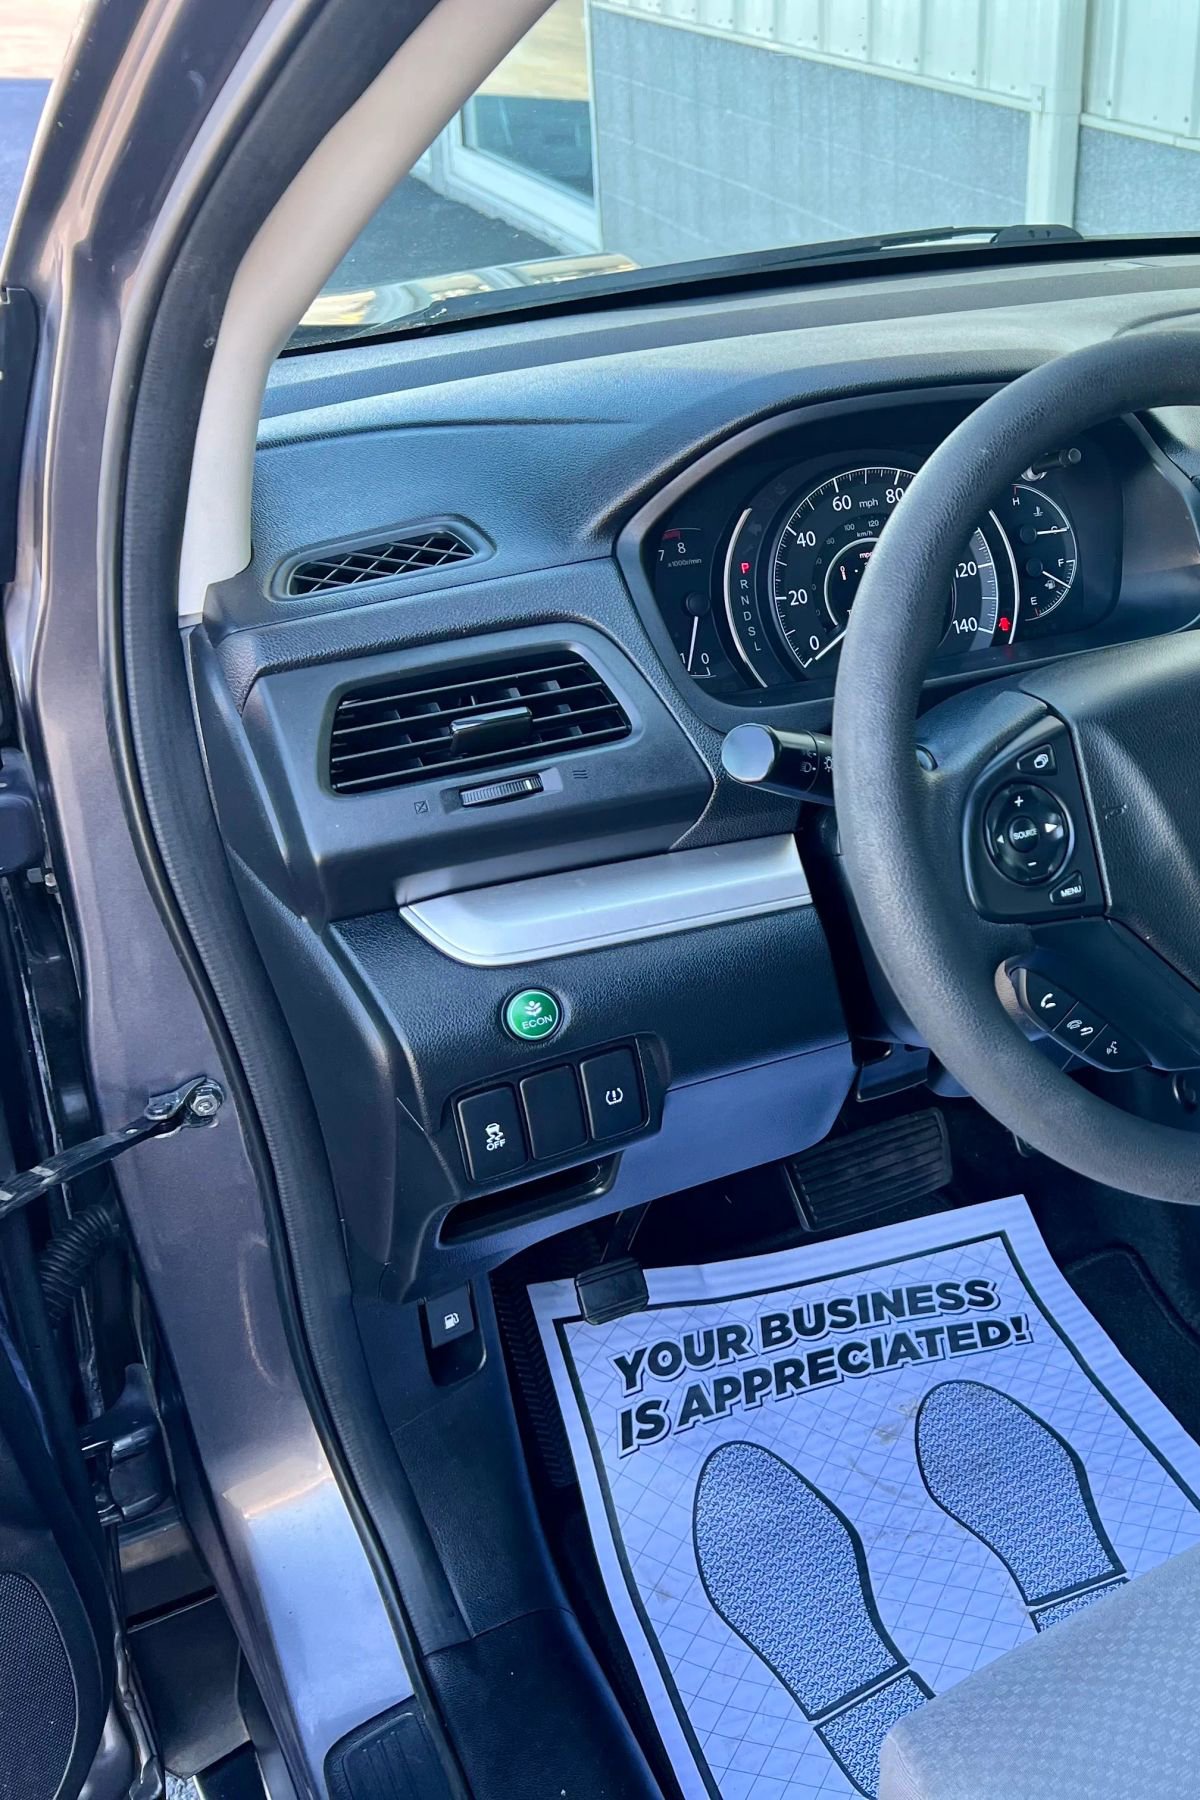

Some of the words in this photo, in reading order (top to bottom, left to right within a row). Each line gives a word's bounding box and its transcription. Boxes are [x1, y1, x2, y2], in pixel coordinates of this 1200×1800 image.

[885, 487, 905, 503] 80
[832, 494, 852, 511] 60
[858, 498, 879, 509] mph
[1012, 497, 1020, 506] H
[844, 523, 855, 531] 100
[868, 519, 879, 528] 120
[796, 530, 816, 547] 40
[856, 530, 873, 538] km/h
[677, 542, 687, 554] 8
[657, 549, 665, 562] 7
[740, 562, 750, 574] P
[1057, 558, 1065, 568] F
[740, 579, 749, 589] R
[740, 595, 750, 605] N
[788, 588, 808, 606] 20
[1031, 596, 1038, 606] E
[743, 611, 752, 621] D
[747, 626, 756, 636] S
[953, 616, 978, 634] 140
[754, 641, 762, 651] L
[809, 635, 820, 650] 0
[700, 652, 710, 664] 0
[1013, 828, 1038, 840] SOURCE
[1060, 885, 1082, 897] MENU
[521, 1014, 552, 1029] ECON
[486, 1138, 506, 1151] OFF
[612, 1323, 752, 1393] YOUR
[760, 1278, 998, 1345] BUSINESS
[619, 1399, 668, 1452] IS
[675, 1314, 1031, 1428] APPRECIATED!
